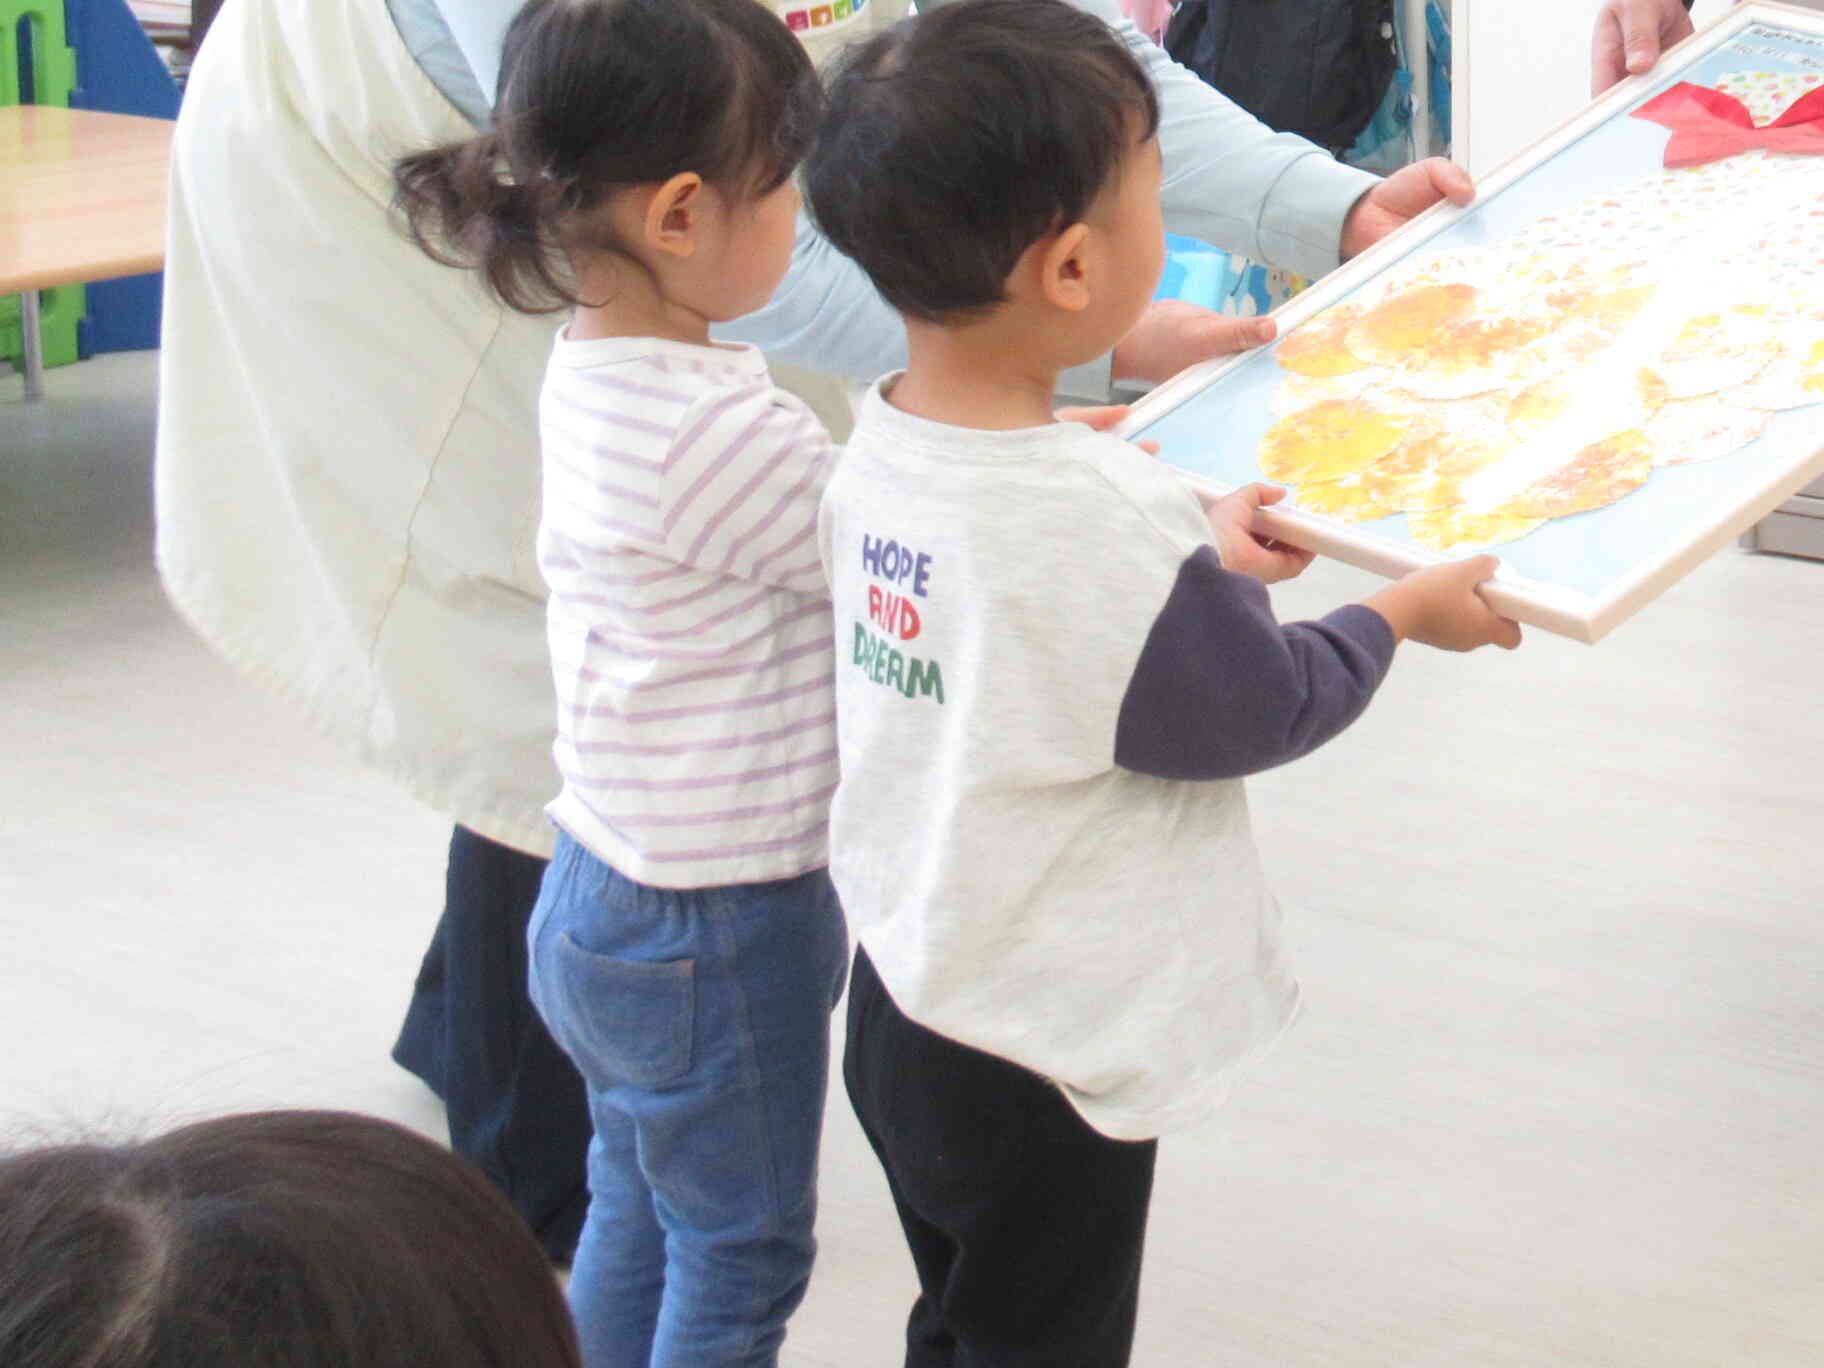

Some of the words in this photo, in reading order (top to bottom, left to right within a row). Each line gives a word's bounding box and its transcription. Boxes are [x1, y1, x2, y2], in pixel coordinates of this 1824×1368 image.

[863, 533, 933, 598] HOPE
[868, 584, 921, 641] AND
[853, 621, 945, 705] DREAM
